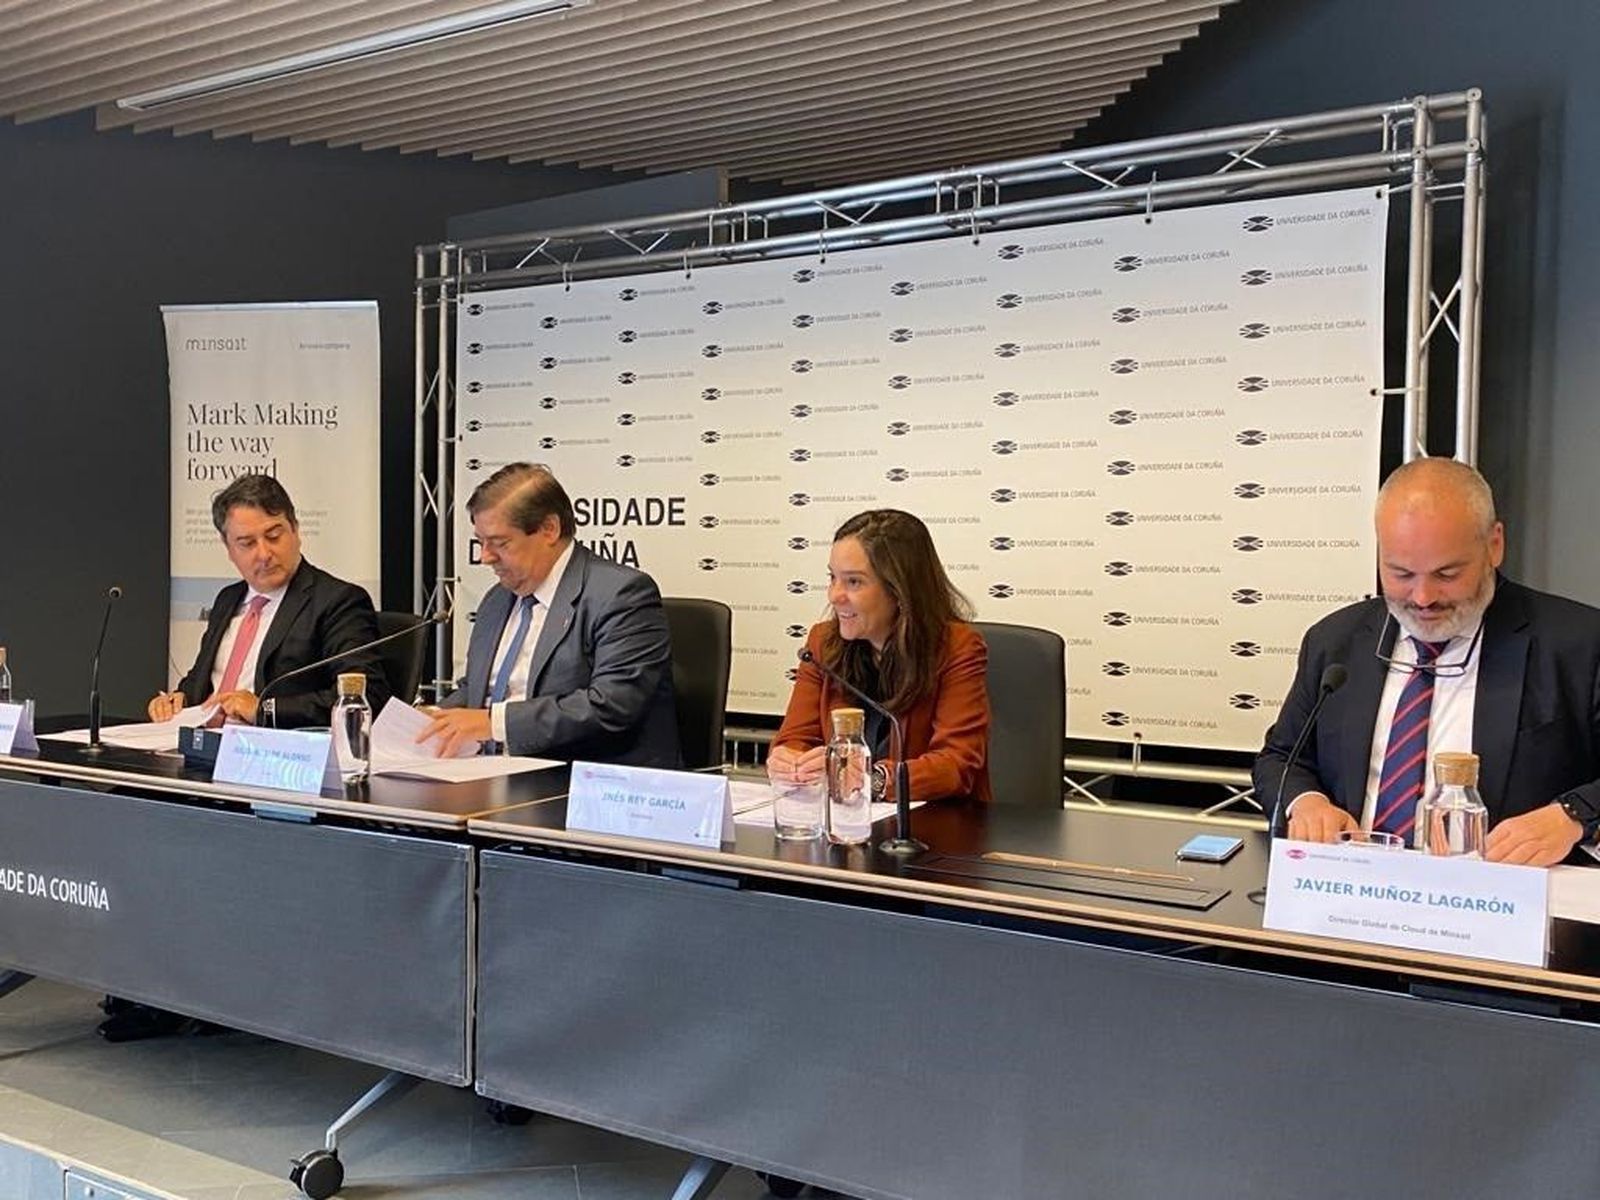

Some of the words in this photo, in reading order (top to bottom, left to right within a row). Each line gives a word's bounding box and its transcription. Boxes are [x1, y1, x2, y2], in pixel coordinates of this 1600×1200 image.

[1276, 212, 1327, 225] UNIVERSIDADE
[1328, 211, 1337, 220] DA
[1340, 206, 1370, 218] CORUÑA
[1145, 254, 1190, 266] UNIVERSIDADE
[1192, 253, 1200, 261] DA
[1202, 249, 1230, 260] CORUÑA
[1275, 267, 1325, 280] UNIVERSIDADE
[1327, 266, 1336, 275] DA
[1338, 263, 1369, 274] CORUÑA
[1143, 306, 1189, 317] UNIVERSIDADE
[1190, 305, 1198, 313] DA
[1201, 302, 1228, 313] CORUÑA
[1273, 322, 1323, 334] UNIVERSIDADE
[1325, 321, 1333, 330] DA
[1336, 318, 1366, 329] CORUÑA
[186, 337, 247, 351] minsait
[1141, 358, 1186, 369] UNIVERSIDADE
[1188, 358, 1196, 366] DA
[1199, 355, 1226, 365] CORUÑA
[1271, 377, 1321, 387] UNIVERSIDADE
[1323, 376, 1332, 385] DA
[1334, 374, 1365, 384] CORUÑA
[187, 402, 247, 425] Mark
[254, 402, 339, 430] Making
[1140, 411, 1185, 420] UNIVERSIDADE
[1197, 409, 1224, 418] CORUÑA
[1270, 431, 1319, 441] UNIVERSIDADE
[1321, 431, 1330, 439] DA
[1333, 429, 1363, 439] CORUÑA
[187, 430, 223, 453] the
[230, 437, 275, 458] way
[187, 458, 277, 480] forward
[1138, 463, 1183, 471] UNIVERSIDADE
[1195, 461, 1223, 470] CORUÑA
[1268, 486, 1318, 494] UNIVERSIDADE
[1320, 485, 1328, 493] DA
[1331, 484, 1361, 493] CORUÑA
[574, 497, 686, 526] SIDADE
[1136, 515, 1181, 523] UNIVERSIDADE
[1193, 514, 1220, 522] CORUÑA
[1266, 540, 1316, 548] UNIVERSIDADE
[1318, 540, 1326, 548] DA
[1329, 539, 1359, 548] CORUÑA
[1182, 566, 1190, 574] DA
[1192, 566, 1219, 574] CORUÑA
[1265, 593, 1315, 602] UNIVERSIDADE
[1316, 594, 1325, 602] DA
[1328, 594, 1358, 603] CORUÑA
[1134, 616, 1179, 625] UNIVERSIDADE
[1181, 617, 1188, 625] DA
[1191, 617, 1218, 626] CORUÑA
[1133, 666, 1178, 676] UNIVERSIDADE
[1190, 668, 1217, 678] CORUÑA
[1132, 717, 1177, 727] UNIVERSIDADE
[1178, 720, 1186, 728] DA
[1189, 720, 1216, 730] CORUÑA
[602, 790, 625, 803] INÉS
[627, 795, 646, 806] REY
[648, 797, 686, 811] GARCÍA
[27, 873, 47, 898] DA
[50, 878, 110, 911] CORUÑA
[1293, 877, 1354, 896] JAVIER
[1359, 885, 1422, 904] MUÑOZ
[1428, 893, 1516, 915] LAGARÓN
[1328, 914, 1360, 926] Director
[1362, 919, 1388, 929] Global
[1401, 924, 1427, 934] Cloud
[1440, 929, 1472, 940] Minsait
